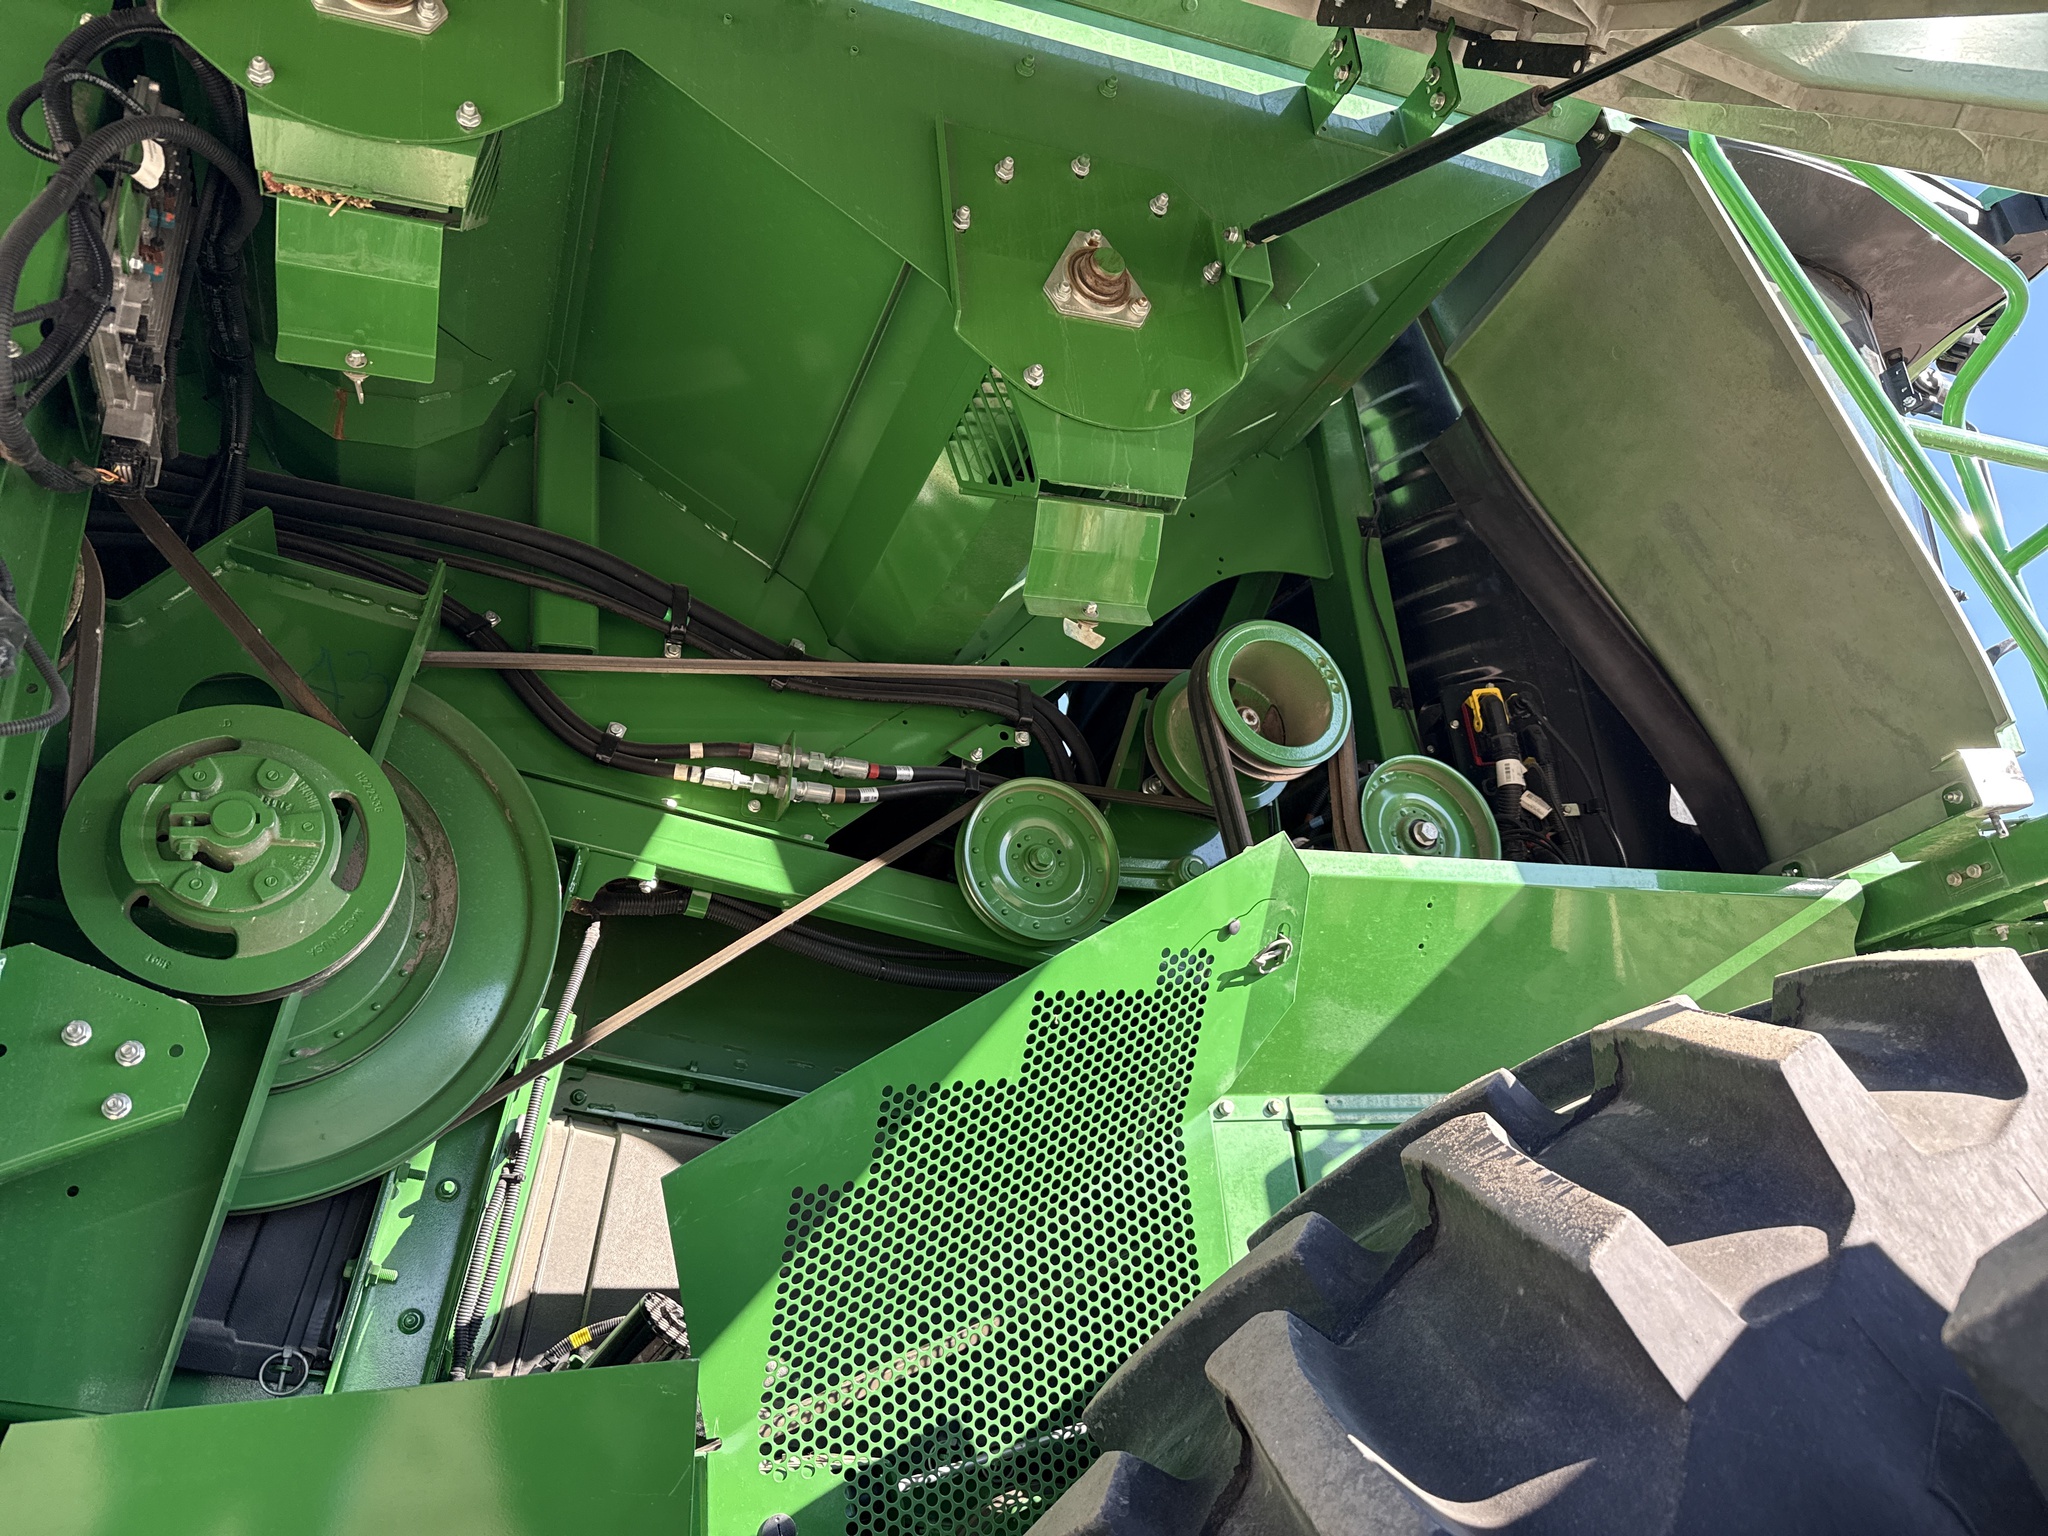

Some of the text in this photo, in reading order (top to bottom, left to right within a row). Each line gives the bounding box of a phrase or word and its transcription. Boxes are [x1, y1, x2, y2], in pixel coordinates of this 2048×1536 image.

[306, 907, 366, 957] MADE IN USA
